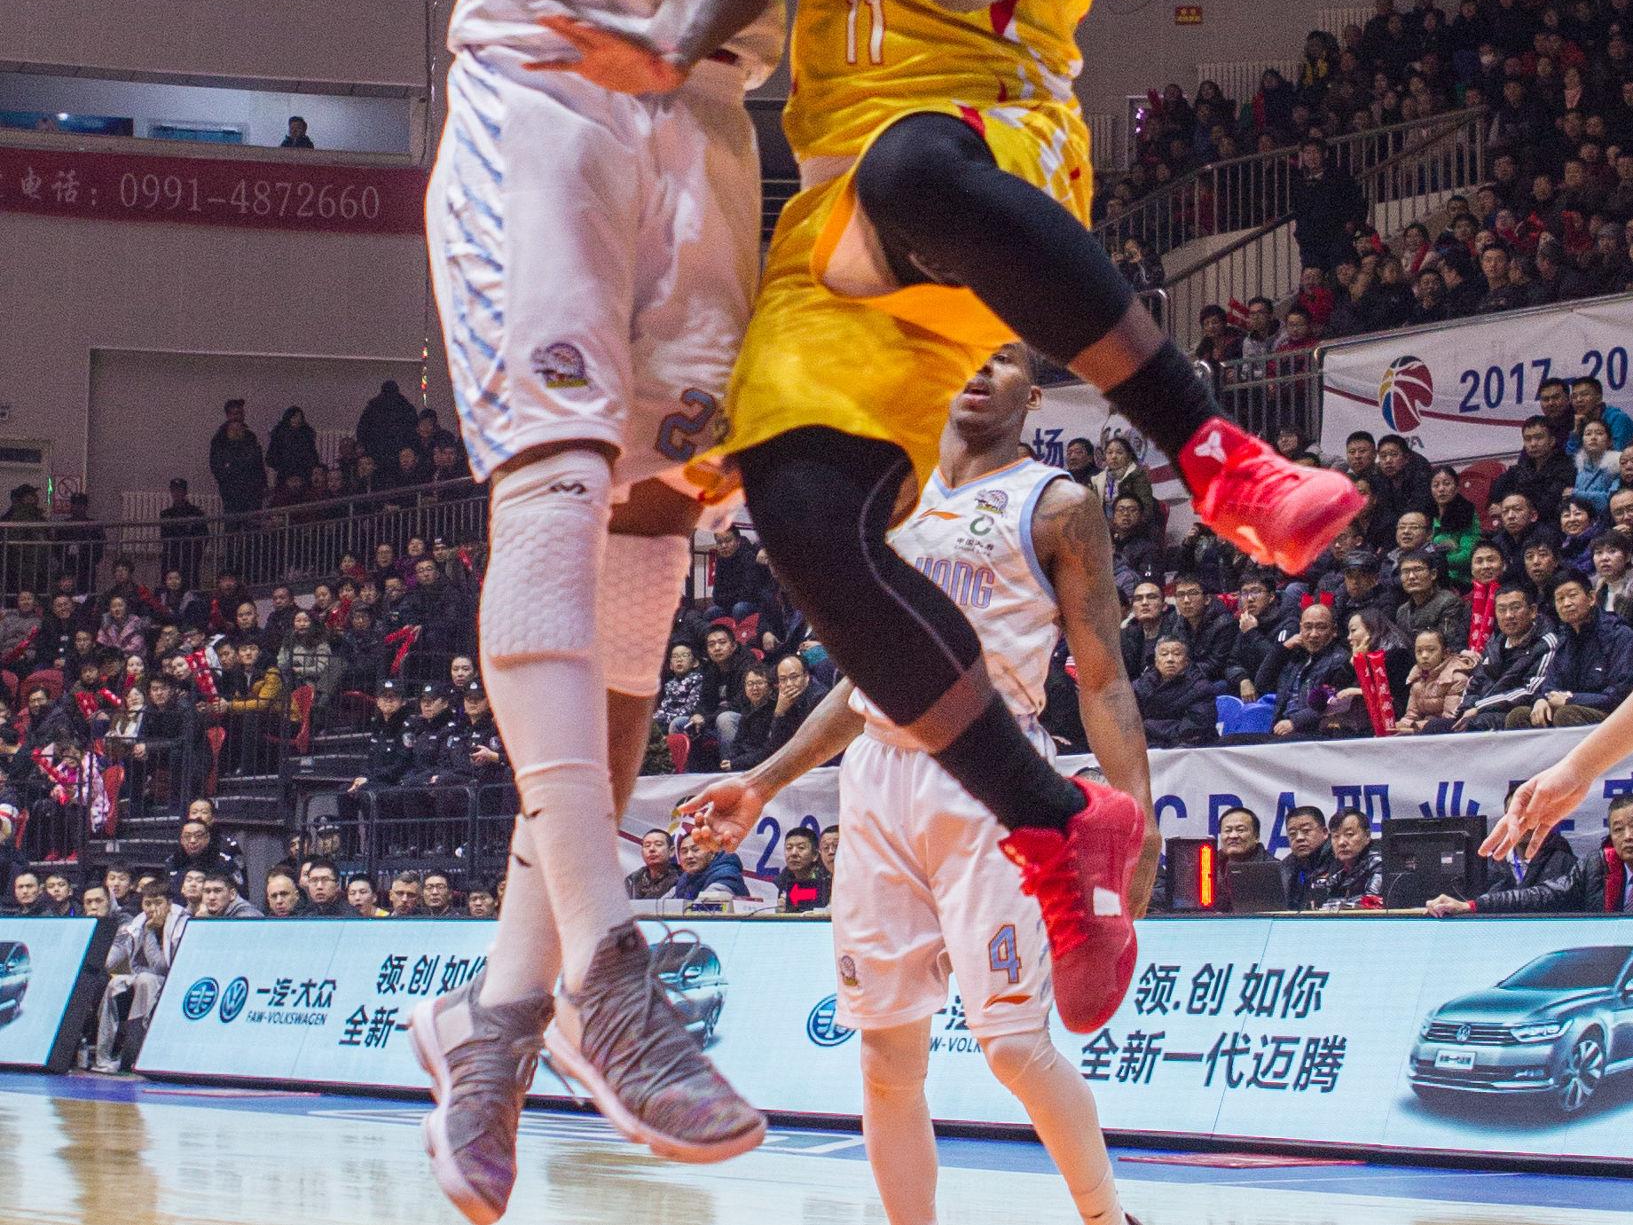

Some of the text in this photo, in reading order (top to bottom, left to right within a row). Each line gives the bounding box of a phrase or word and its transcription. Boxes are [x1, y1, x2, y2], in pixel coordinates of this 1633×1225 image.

[119, 173, 381, 220] 0991-4872660
[988, 924, 1022, 984] 4
[246, 1011, 328, 1026] FAW-VOLKSWAGEN
[1080, 1027, 1347, 1094] 全新一代迈腾
